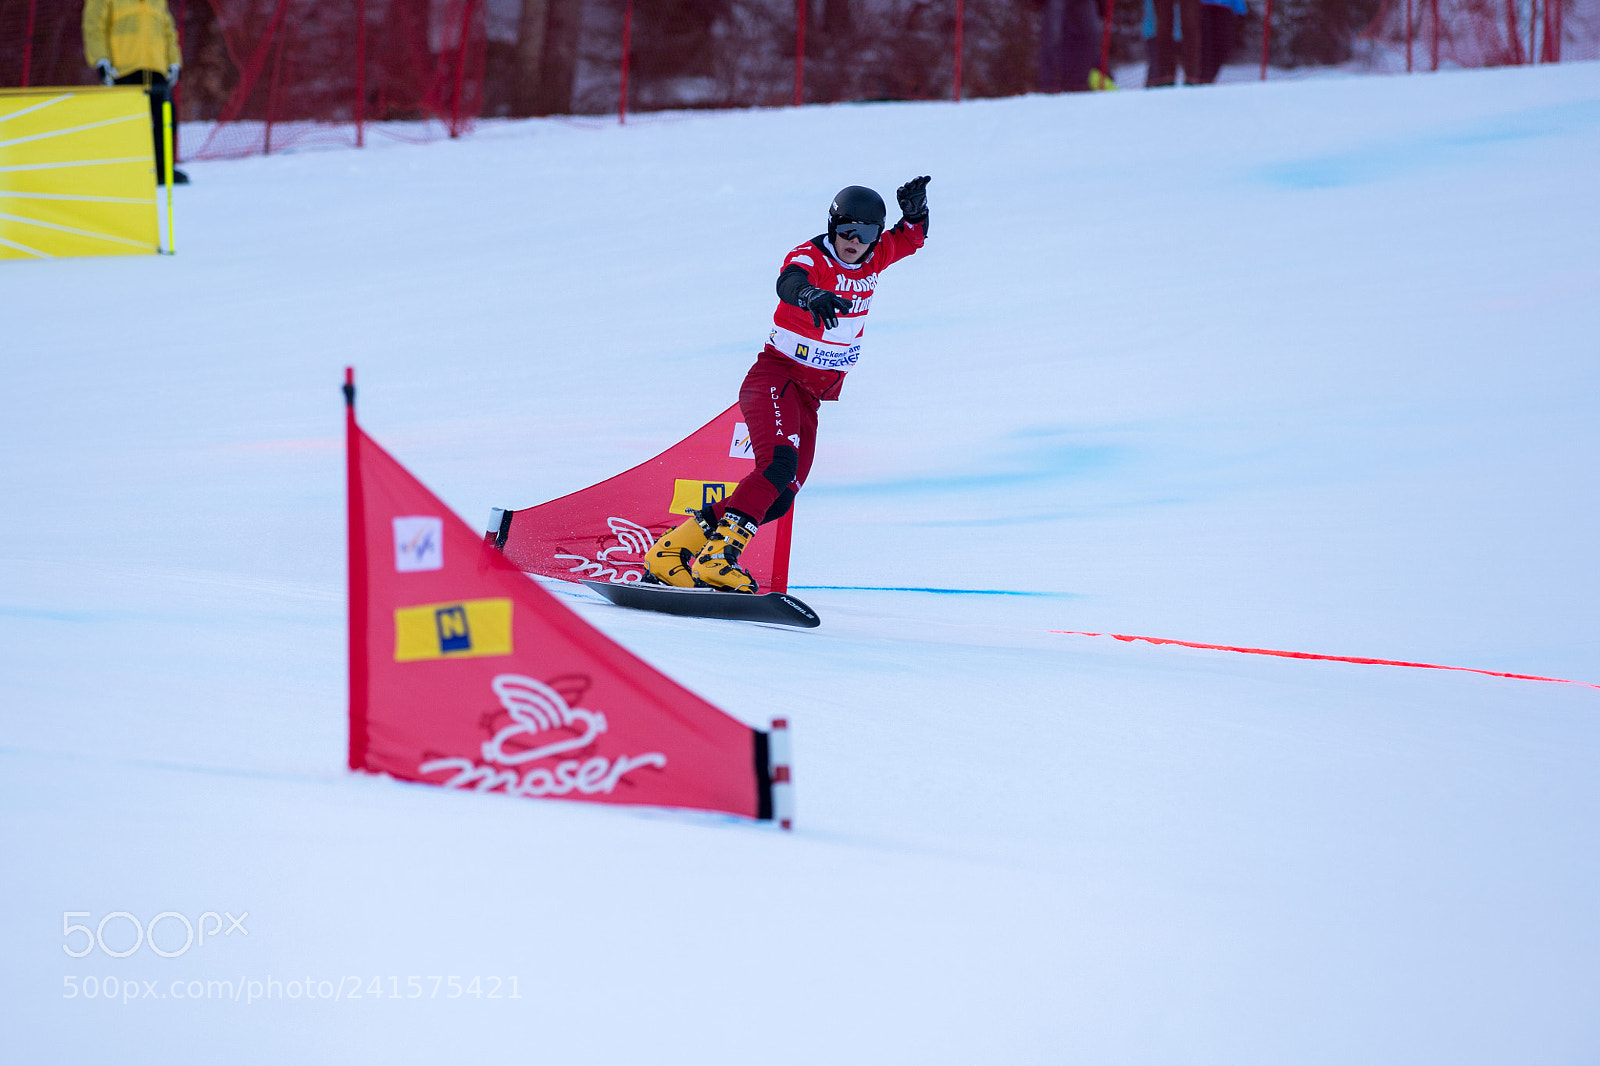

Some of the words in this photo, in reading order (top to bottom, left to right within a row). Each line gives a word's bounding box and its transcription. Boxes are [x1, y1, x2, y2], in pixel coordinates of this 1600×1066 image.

[770, 386, 784, 436] POLSKA
[706, 487, 722, 504] N
[780, 596, 815, 619] NOBILE
[440, 609, 466, 640] N
[418, 752, 667, 796] moser
